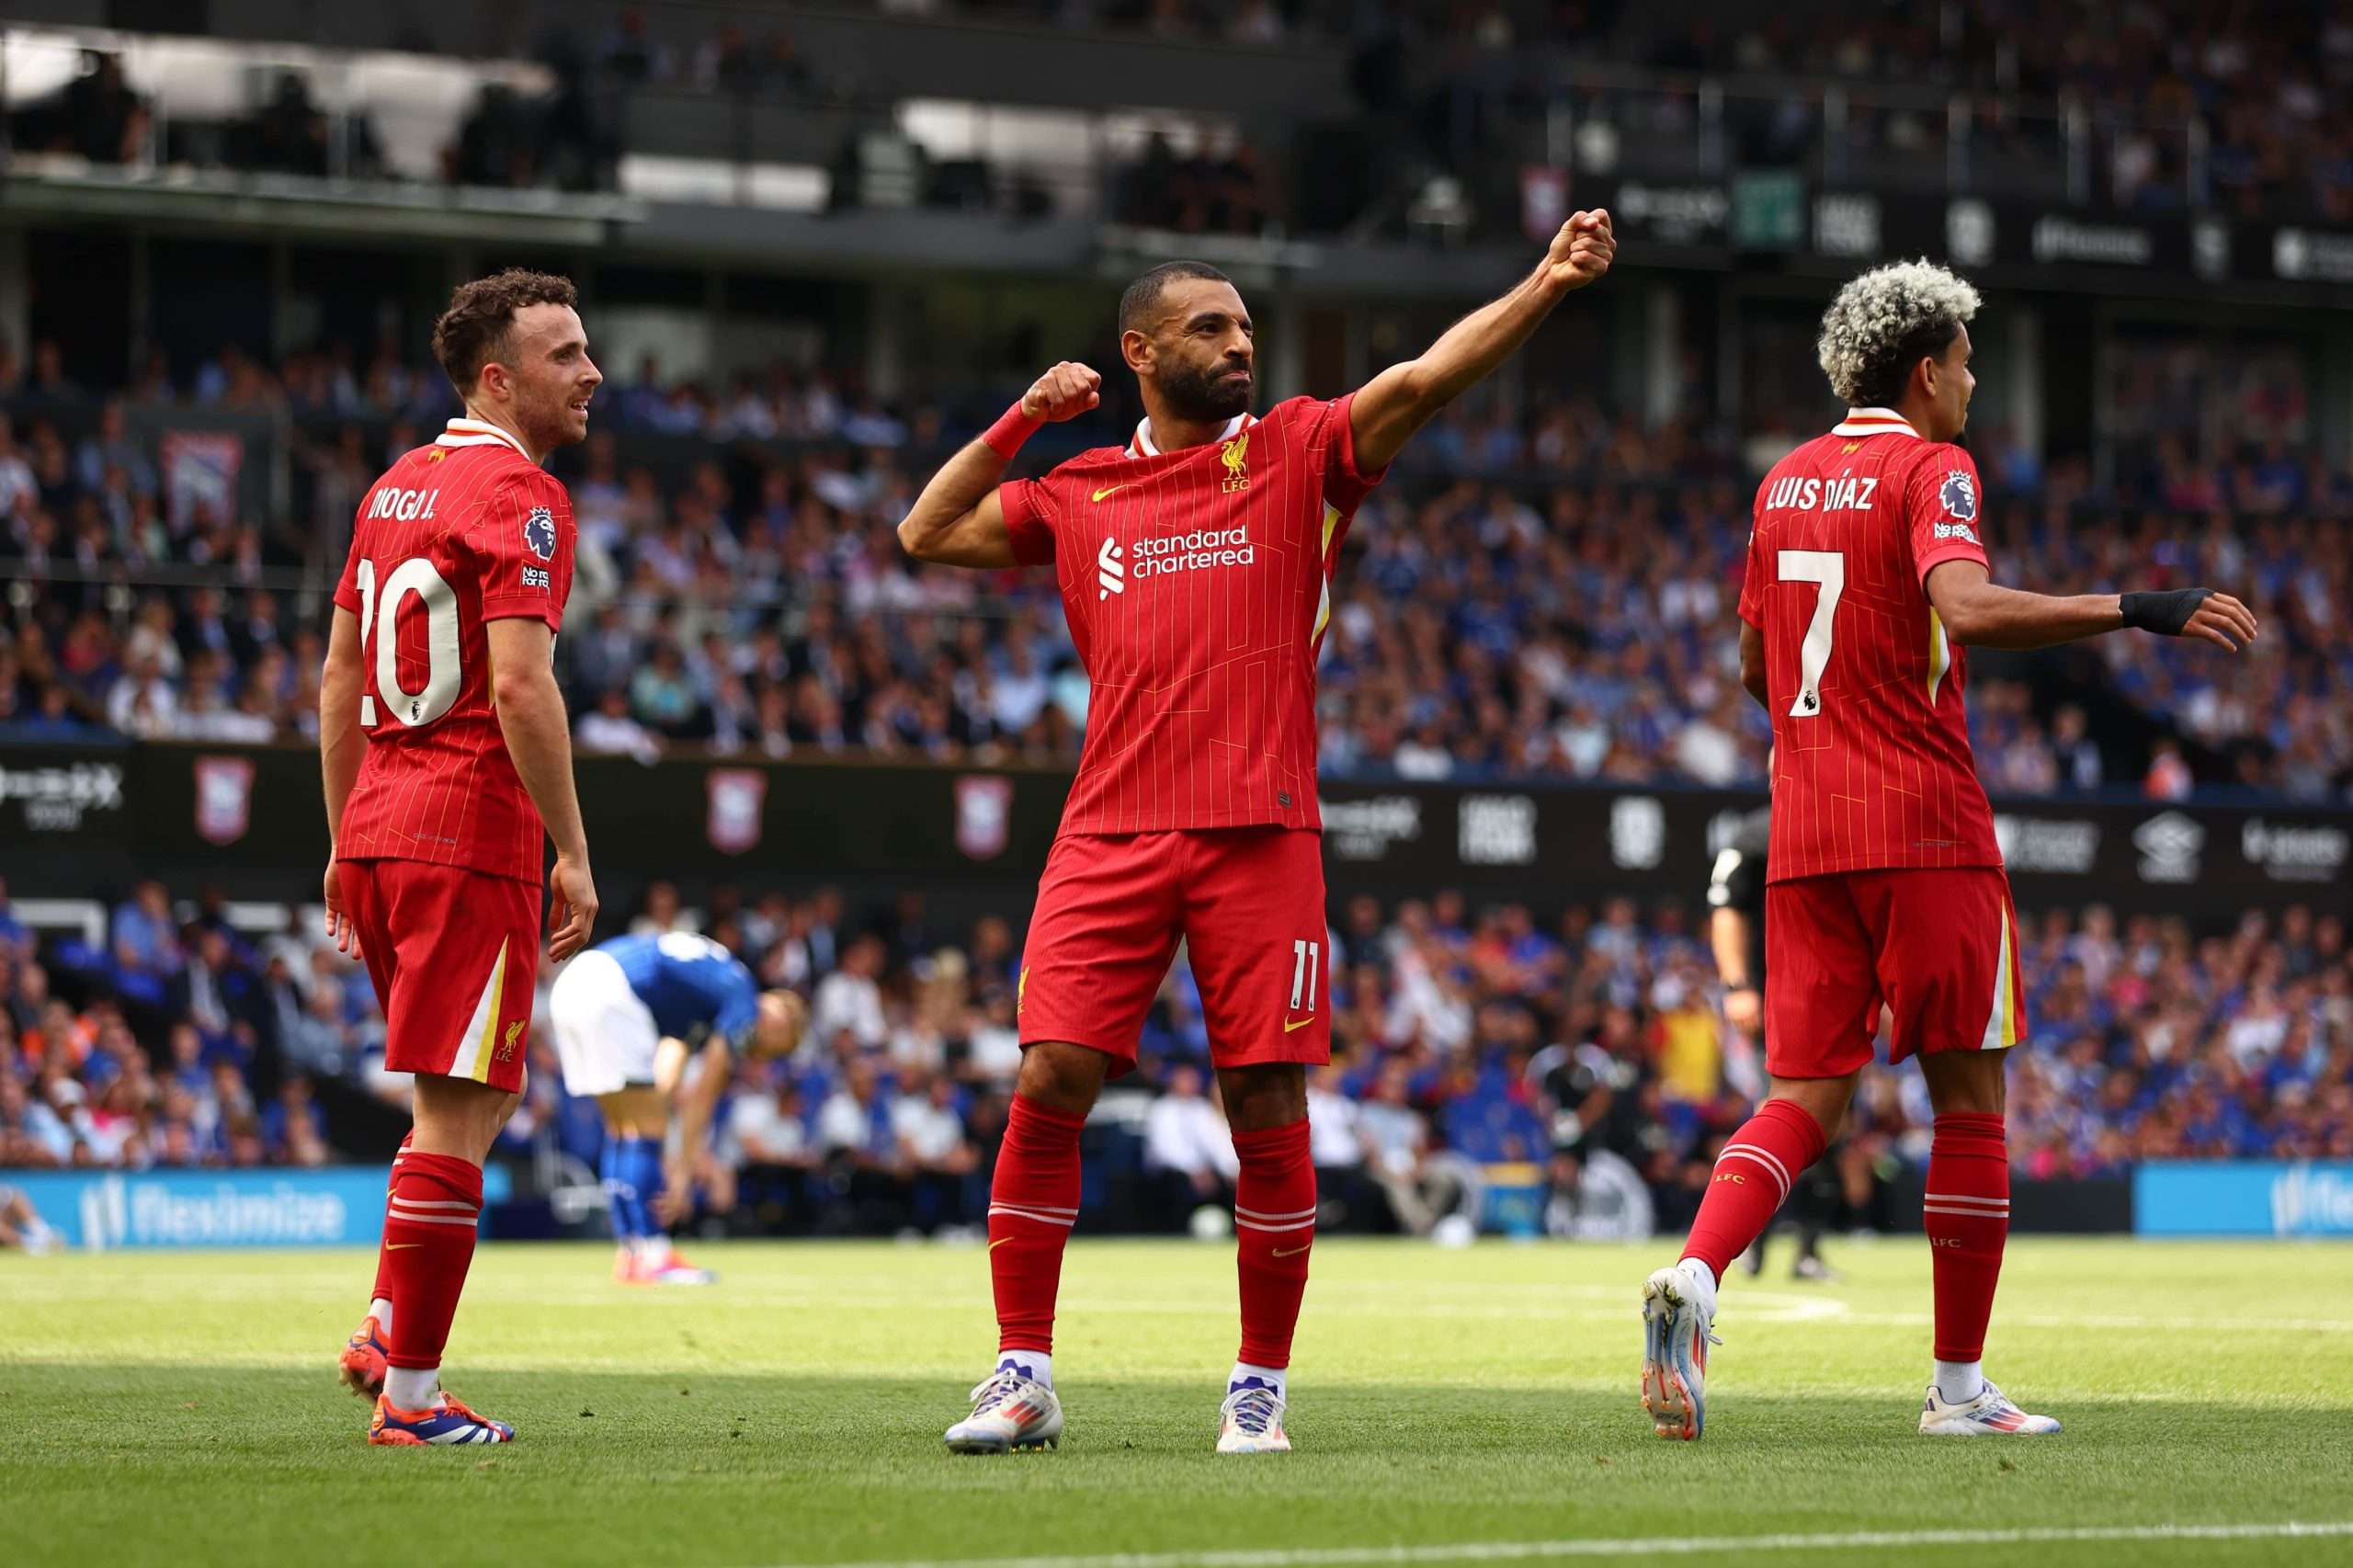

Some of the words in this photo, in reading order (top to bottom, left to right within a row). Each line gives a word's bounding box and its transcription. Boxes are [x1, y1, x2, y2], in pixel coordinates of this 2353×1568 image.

[420, 488, 439, 520] J.
[1766, 477, 1821, 511] LUIS
[1823, 467, 1878, 512] DÍAZ
[1132, 524, 1246, 559] standard
[1132, 544, 1254, 578] chartered
[1778, 549, 1845, 717] 7
[1290, 939, 1318, 1012] 11
[1931, 1236, 1961, 1248] LFC
